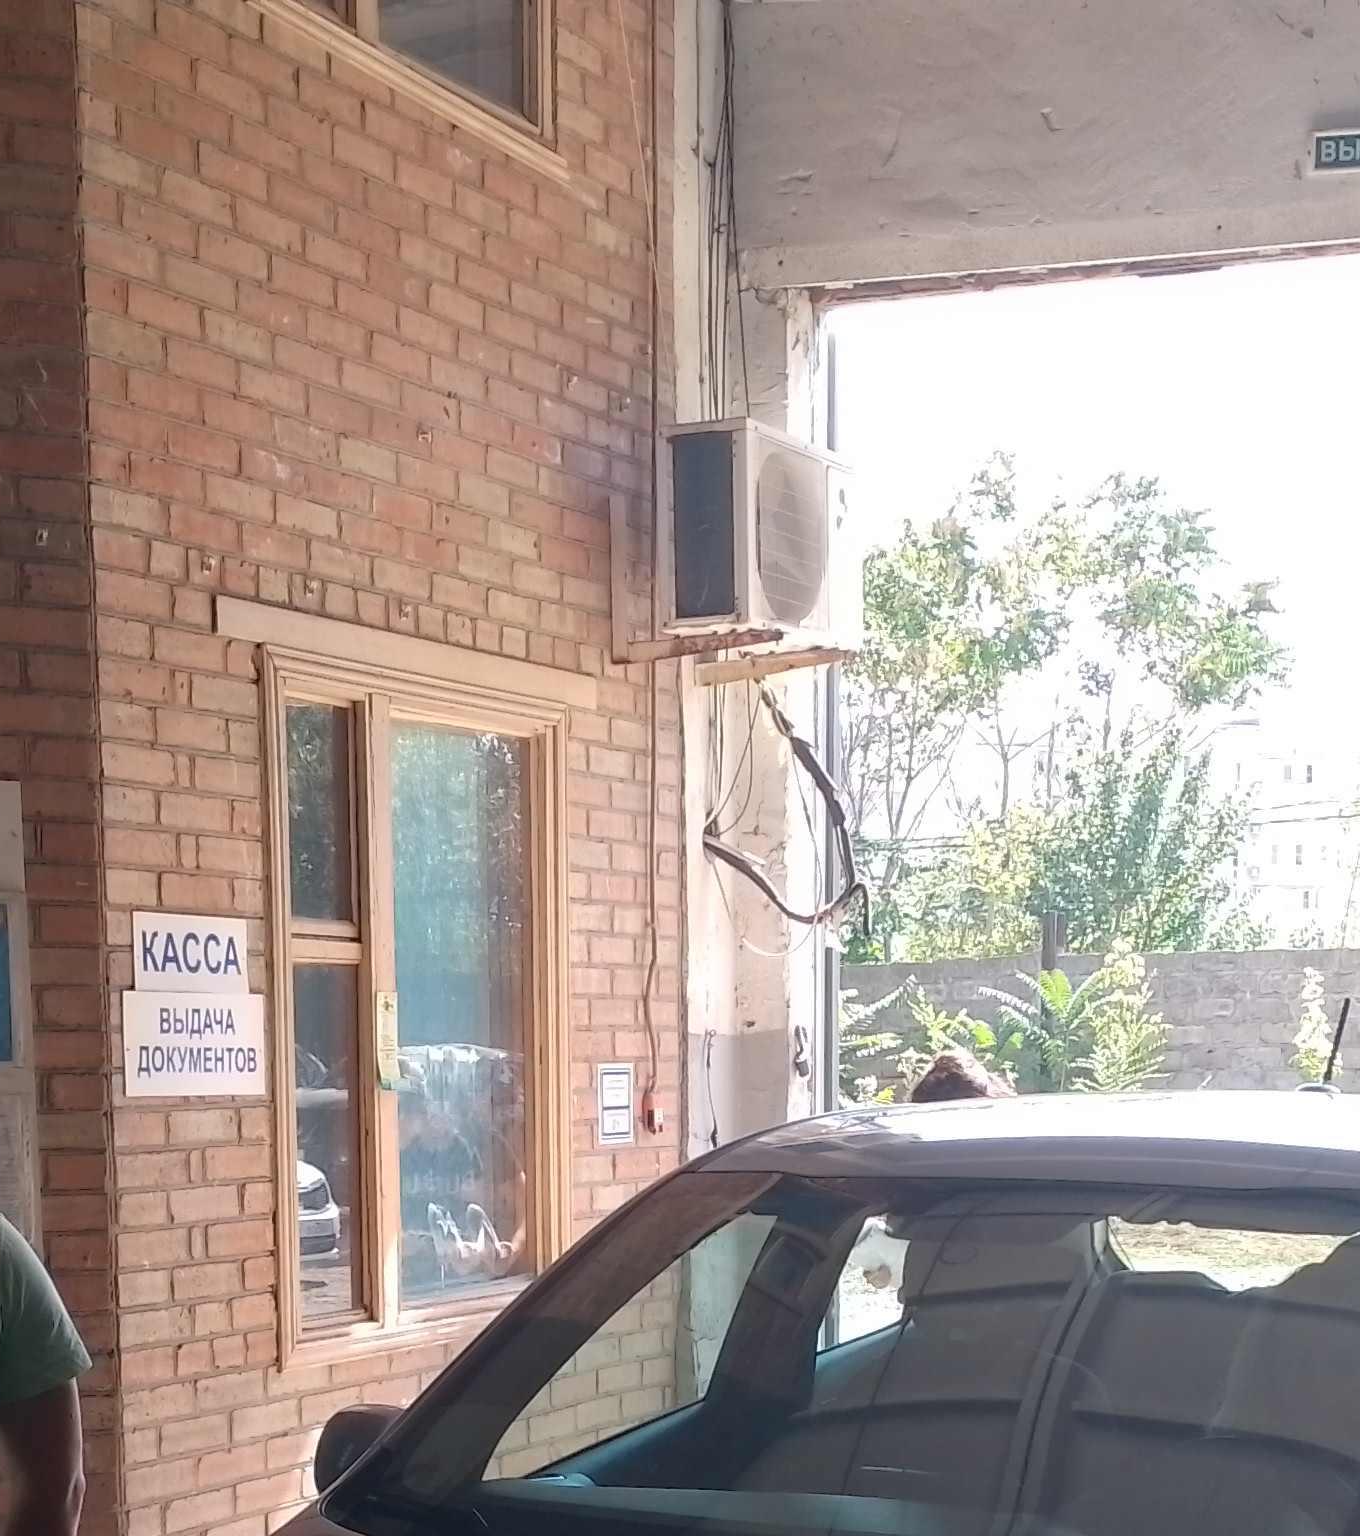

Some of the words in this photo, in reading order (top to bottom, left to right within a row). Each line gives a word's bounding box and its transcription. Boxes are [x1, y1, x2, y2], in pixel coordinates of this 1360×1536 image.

[141, 929, 242, 976] КАССА
[159, 1007, 236, 1040] ВЫДАЧА
[137, 1045, 258, 1078] ДОКУМЕНТОВ
